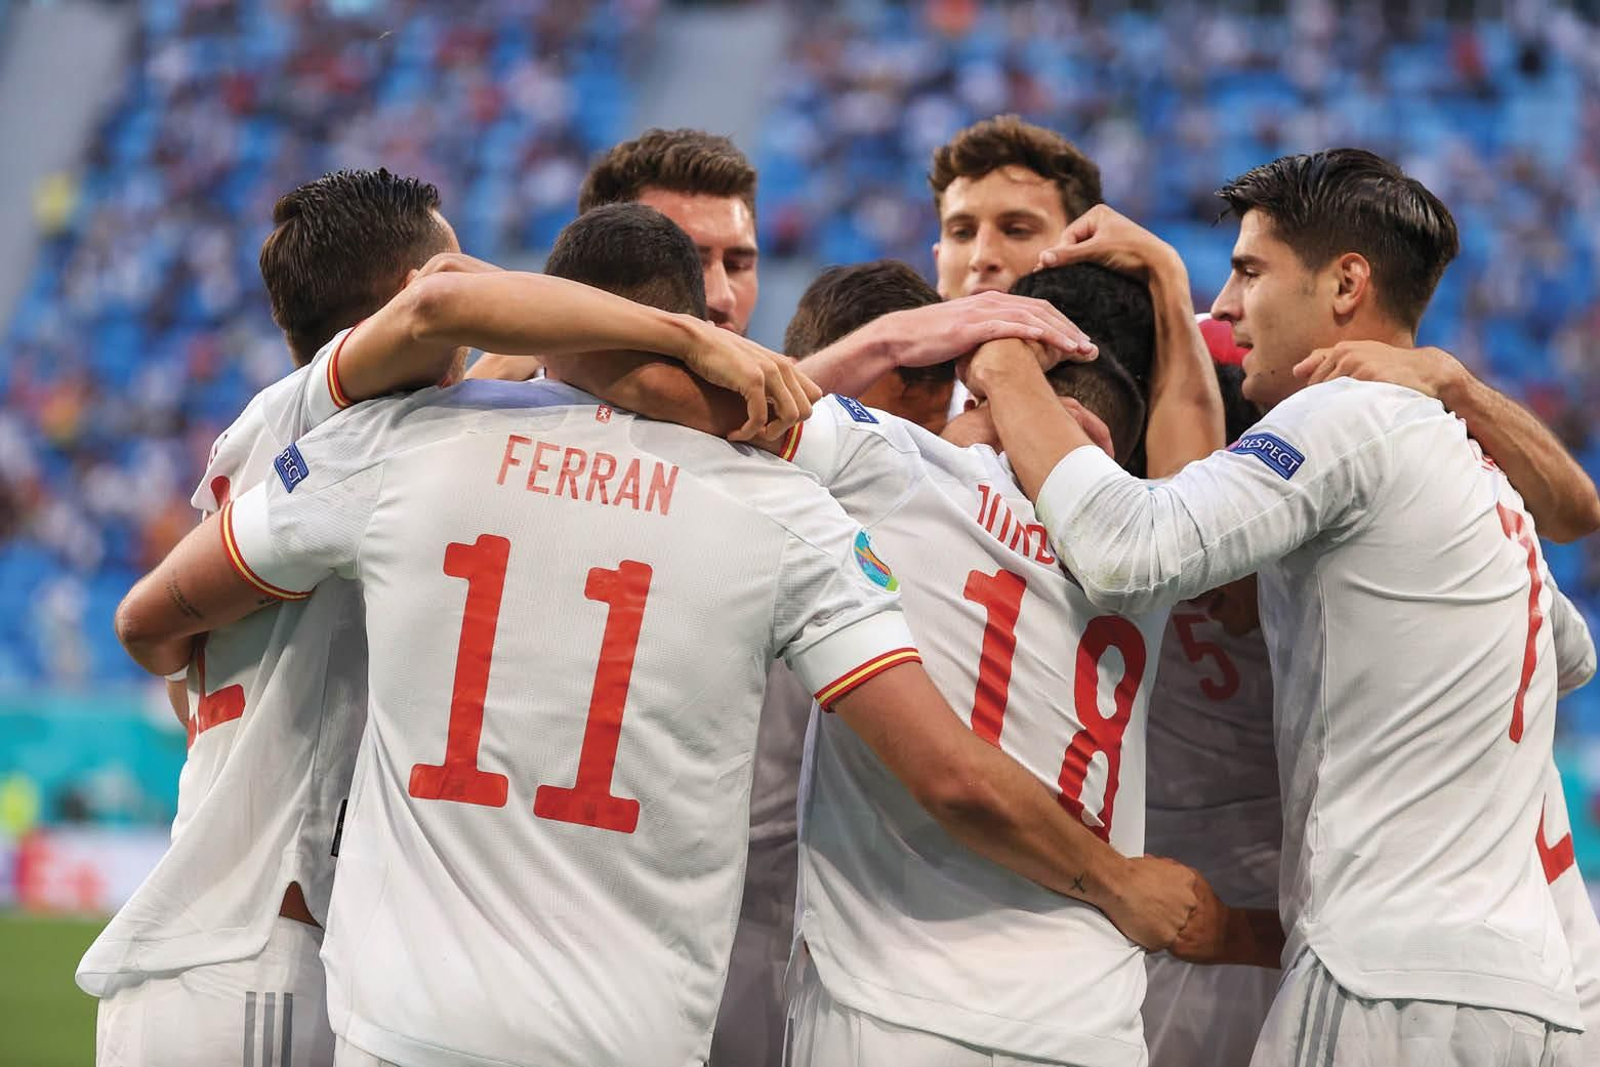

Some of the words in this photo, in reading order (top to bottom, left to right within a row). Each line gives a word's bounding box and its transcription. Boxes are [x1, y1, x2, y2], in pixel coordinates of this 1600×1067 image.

[280, 449, 302, 484] PECT
[497, 434, 679, 516] FERRAN
[1238, 438, 1300, 471] RESPECT
[409, 533, 653, 834] 11
[1172, 614, 1240, 702] 5
[963, 568, 1147, 845] 18
